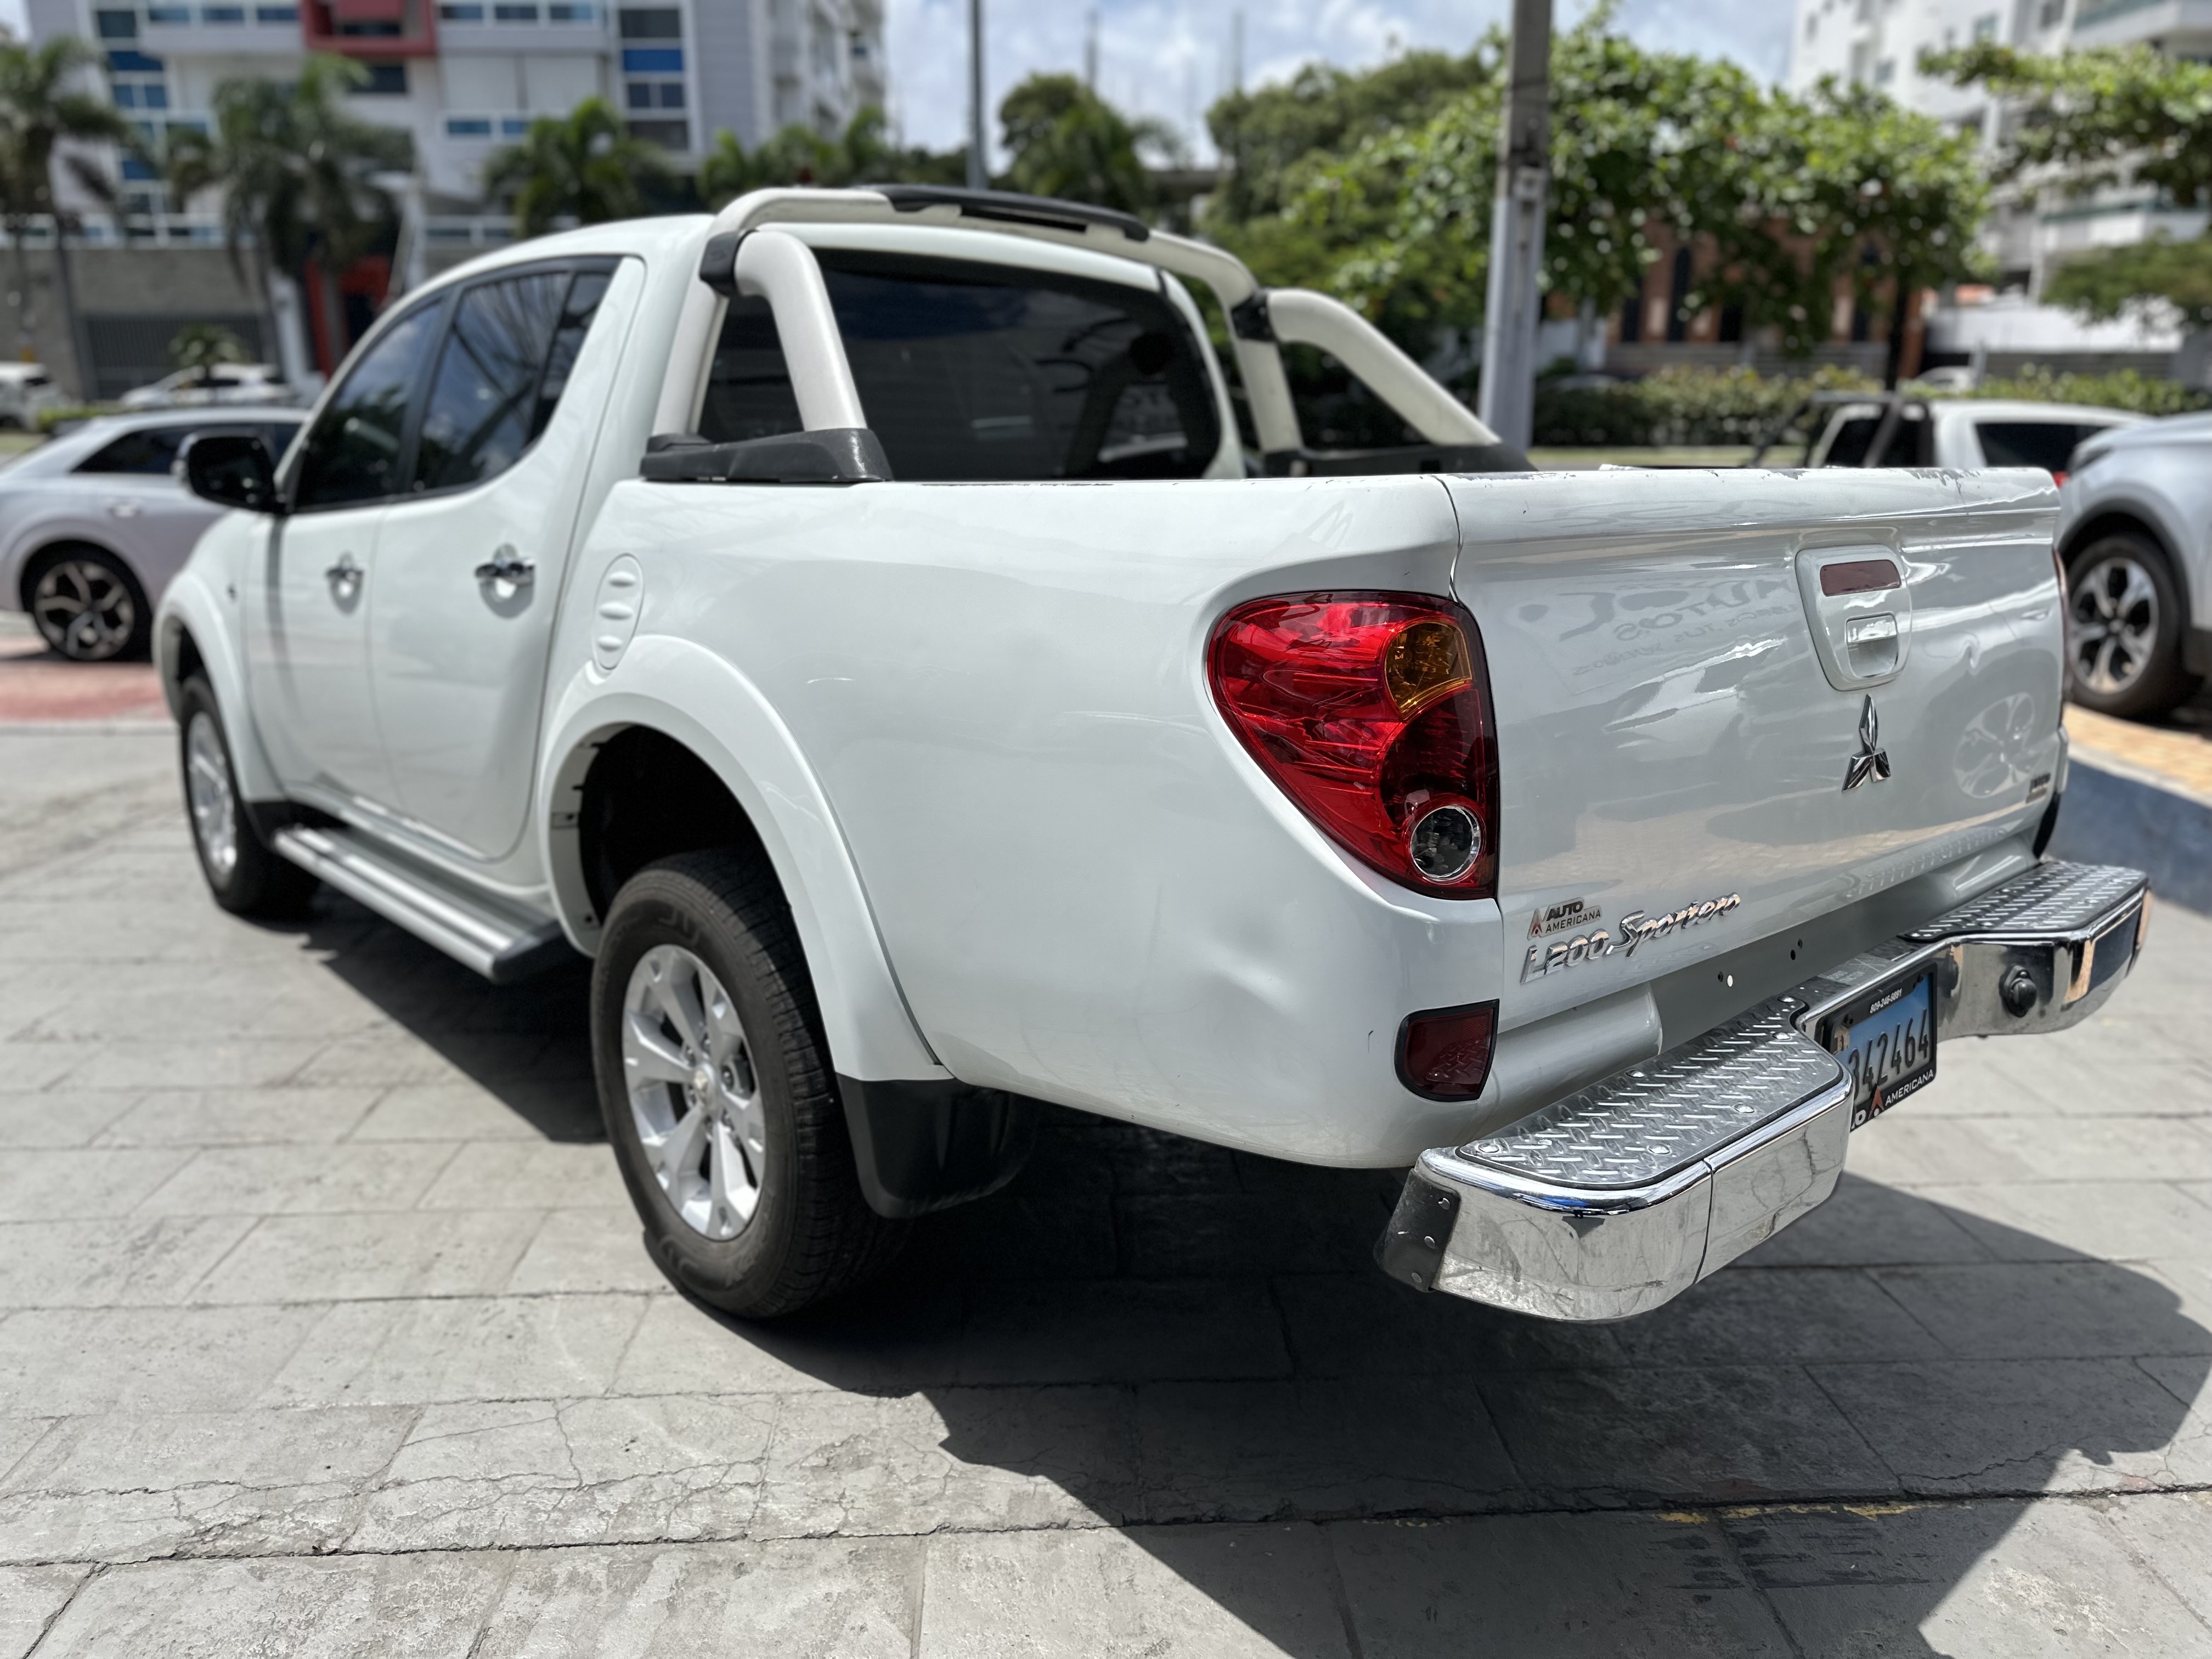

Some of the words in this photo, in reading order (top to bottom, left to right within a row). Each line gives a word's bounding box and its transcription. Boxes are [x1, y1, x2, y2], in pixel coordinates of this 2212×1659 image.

[1545, 909, 1601, 933] AMERICANA
[1546, 901, 1583, 921] AUTO
[1520, 928, 1609, 985] L200
[1602, 892, 1741, 957] Sportero
[1885, 1069, 1933, 1106] AMERICANA
